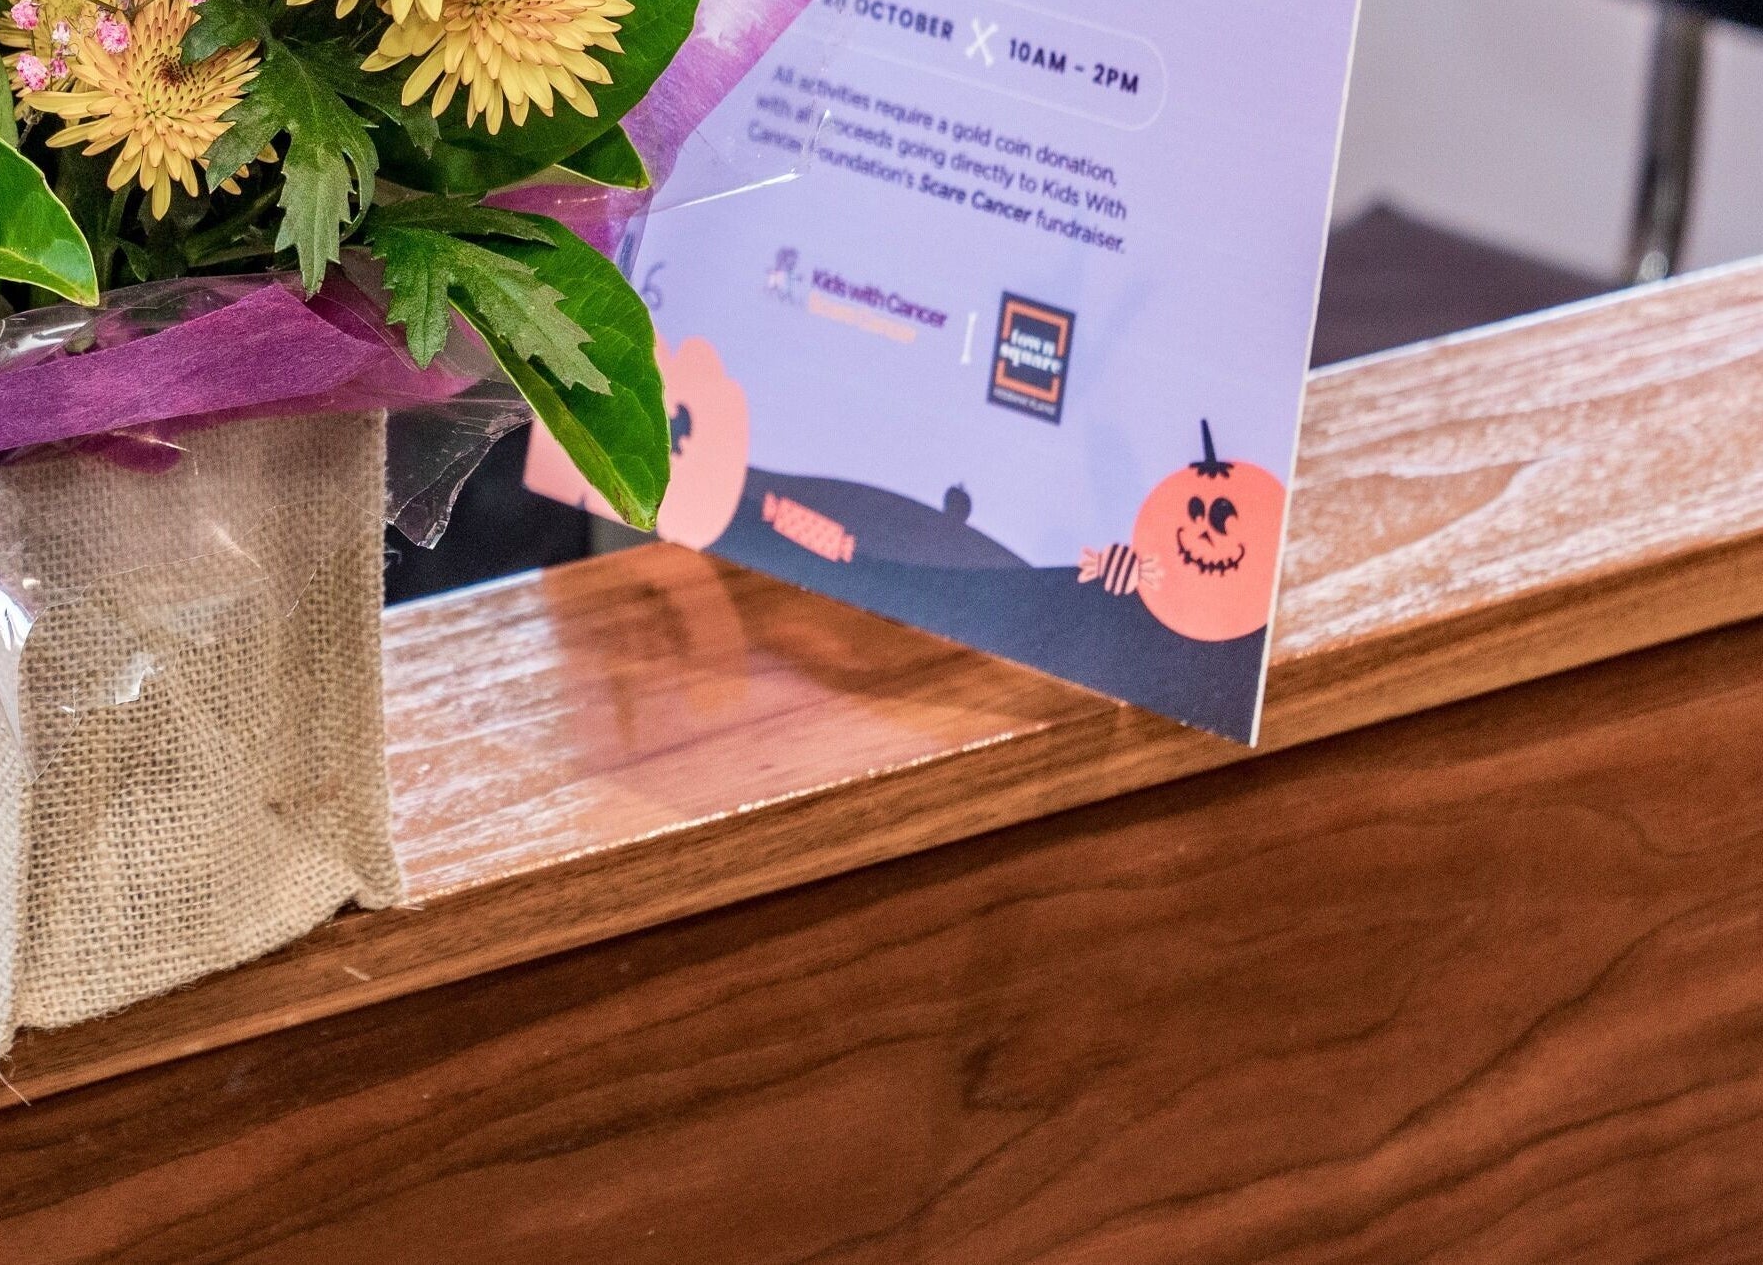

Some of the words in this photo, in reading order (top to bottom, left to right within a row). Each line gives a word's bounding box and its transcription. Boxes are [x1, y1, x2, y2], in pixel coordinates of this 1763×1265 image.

[1009, 38, 1067, 74] 10AM
[1092, 62, 1139, 94] 2PM
[875, 99, 934, 130] require
[937, 119, 948, 134] a
[952, 122, 992, 148] gold
[995, 135, 1031, 159] coin
[1036, 145, 1117, 188] donation,
[898, 138, 946, 169] going
[951, 152, 1014, 190] directly
[1019, 171, 1036, 194] to
[1042, 178, 1079, 207] Kids
[1085, 191, 1127, 221] With
[918, 173, 967, 204] Scare
[971, 189, 1032, 223] Cancer
[1036, 208, 1125, 254] fundraiser.
